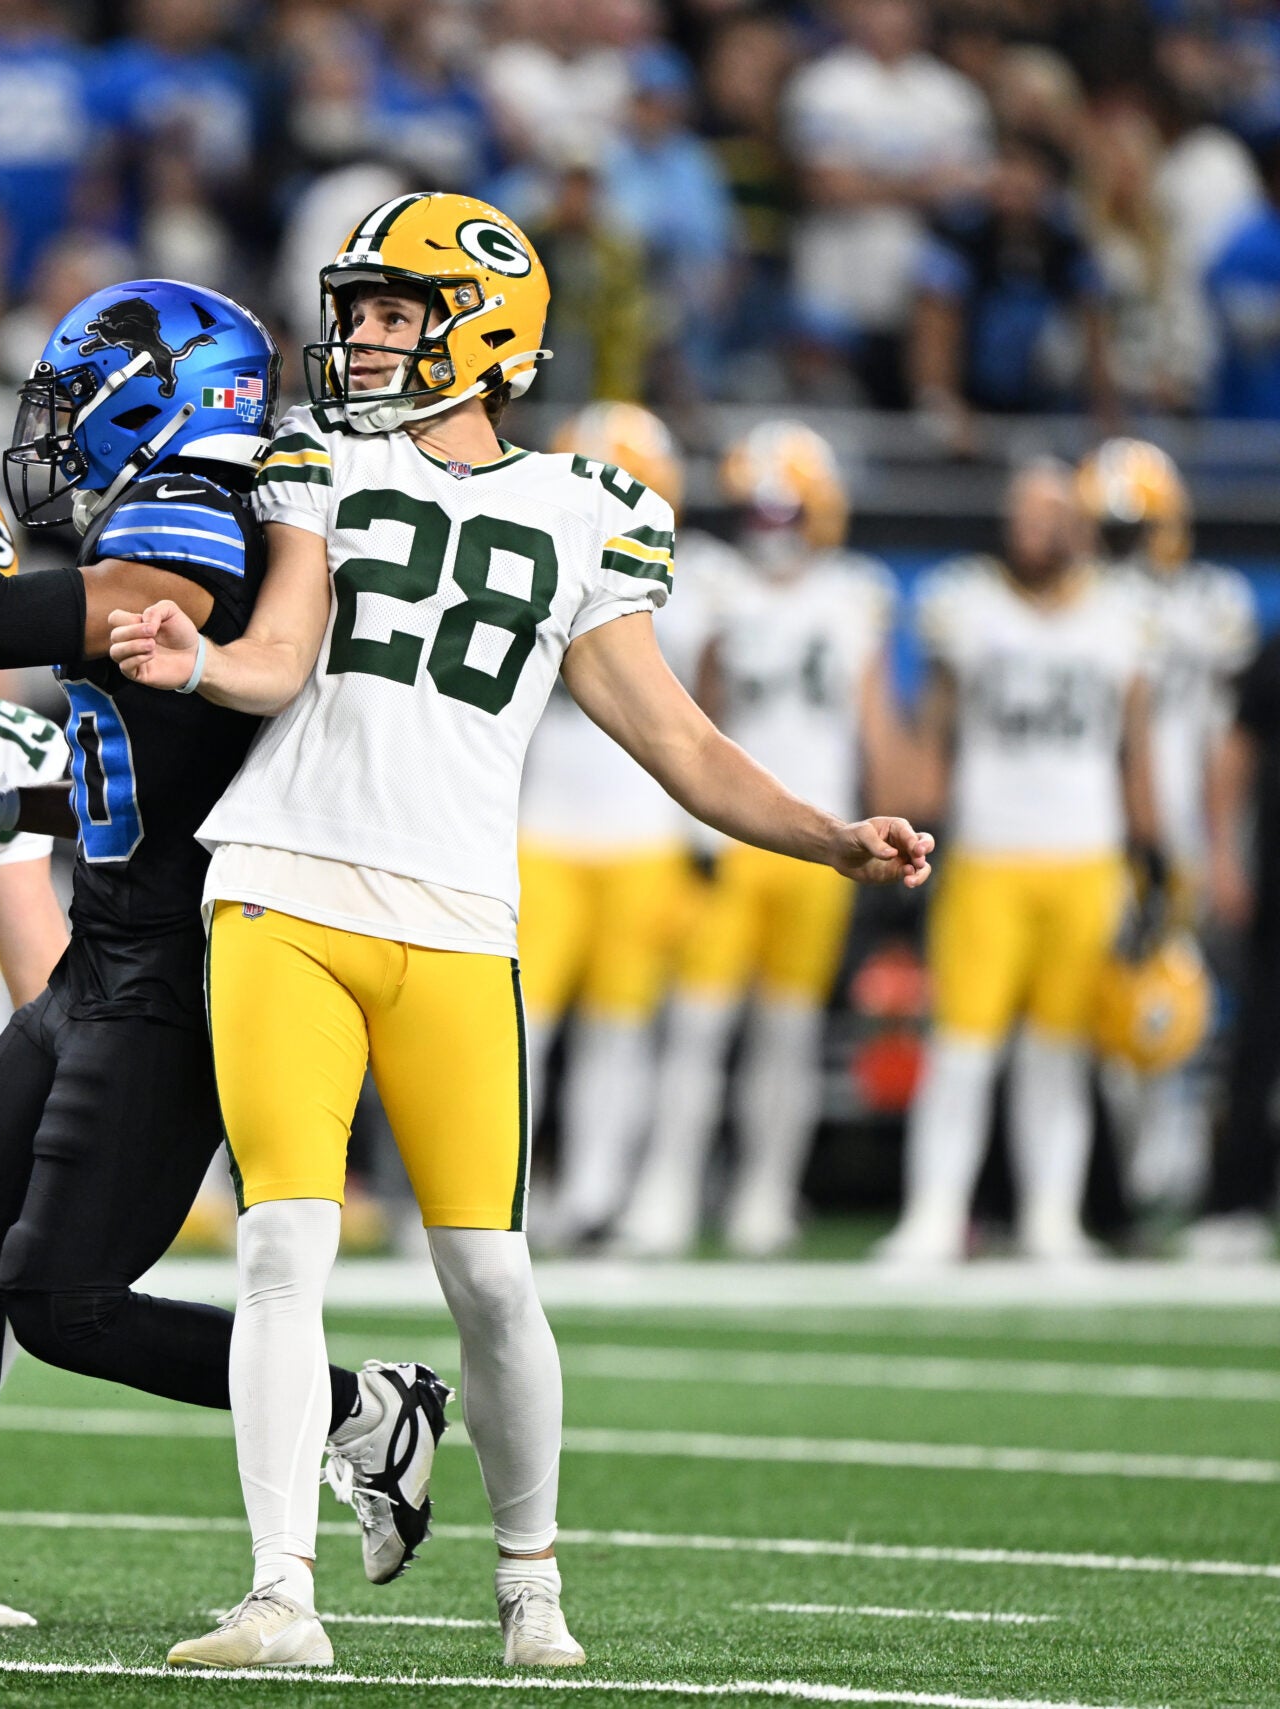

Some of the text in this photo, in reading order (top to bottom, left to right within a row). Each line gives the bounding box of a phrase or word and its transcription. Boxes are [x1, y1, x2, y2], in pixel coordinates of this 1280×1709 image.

[460, 221, 530, 275] G
[236, 401, 263, 418] WCF
[326, 488, 558, 717] 28
[60, 678, 144, 864] 0
